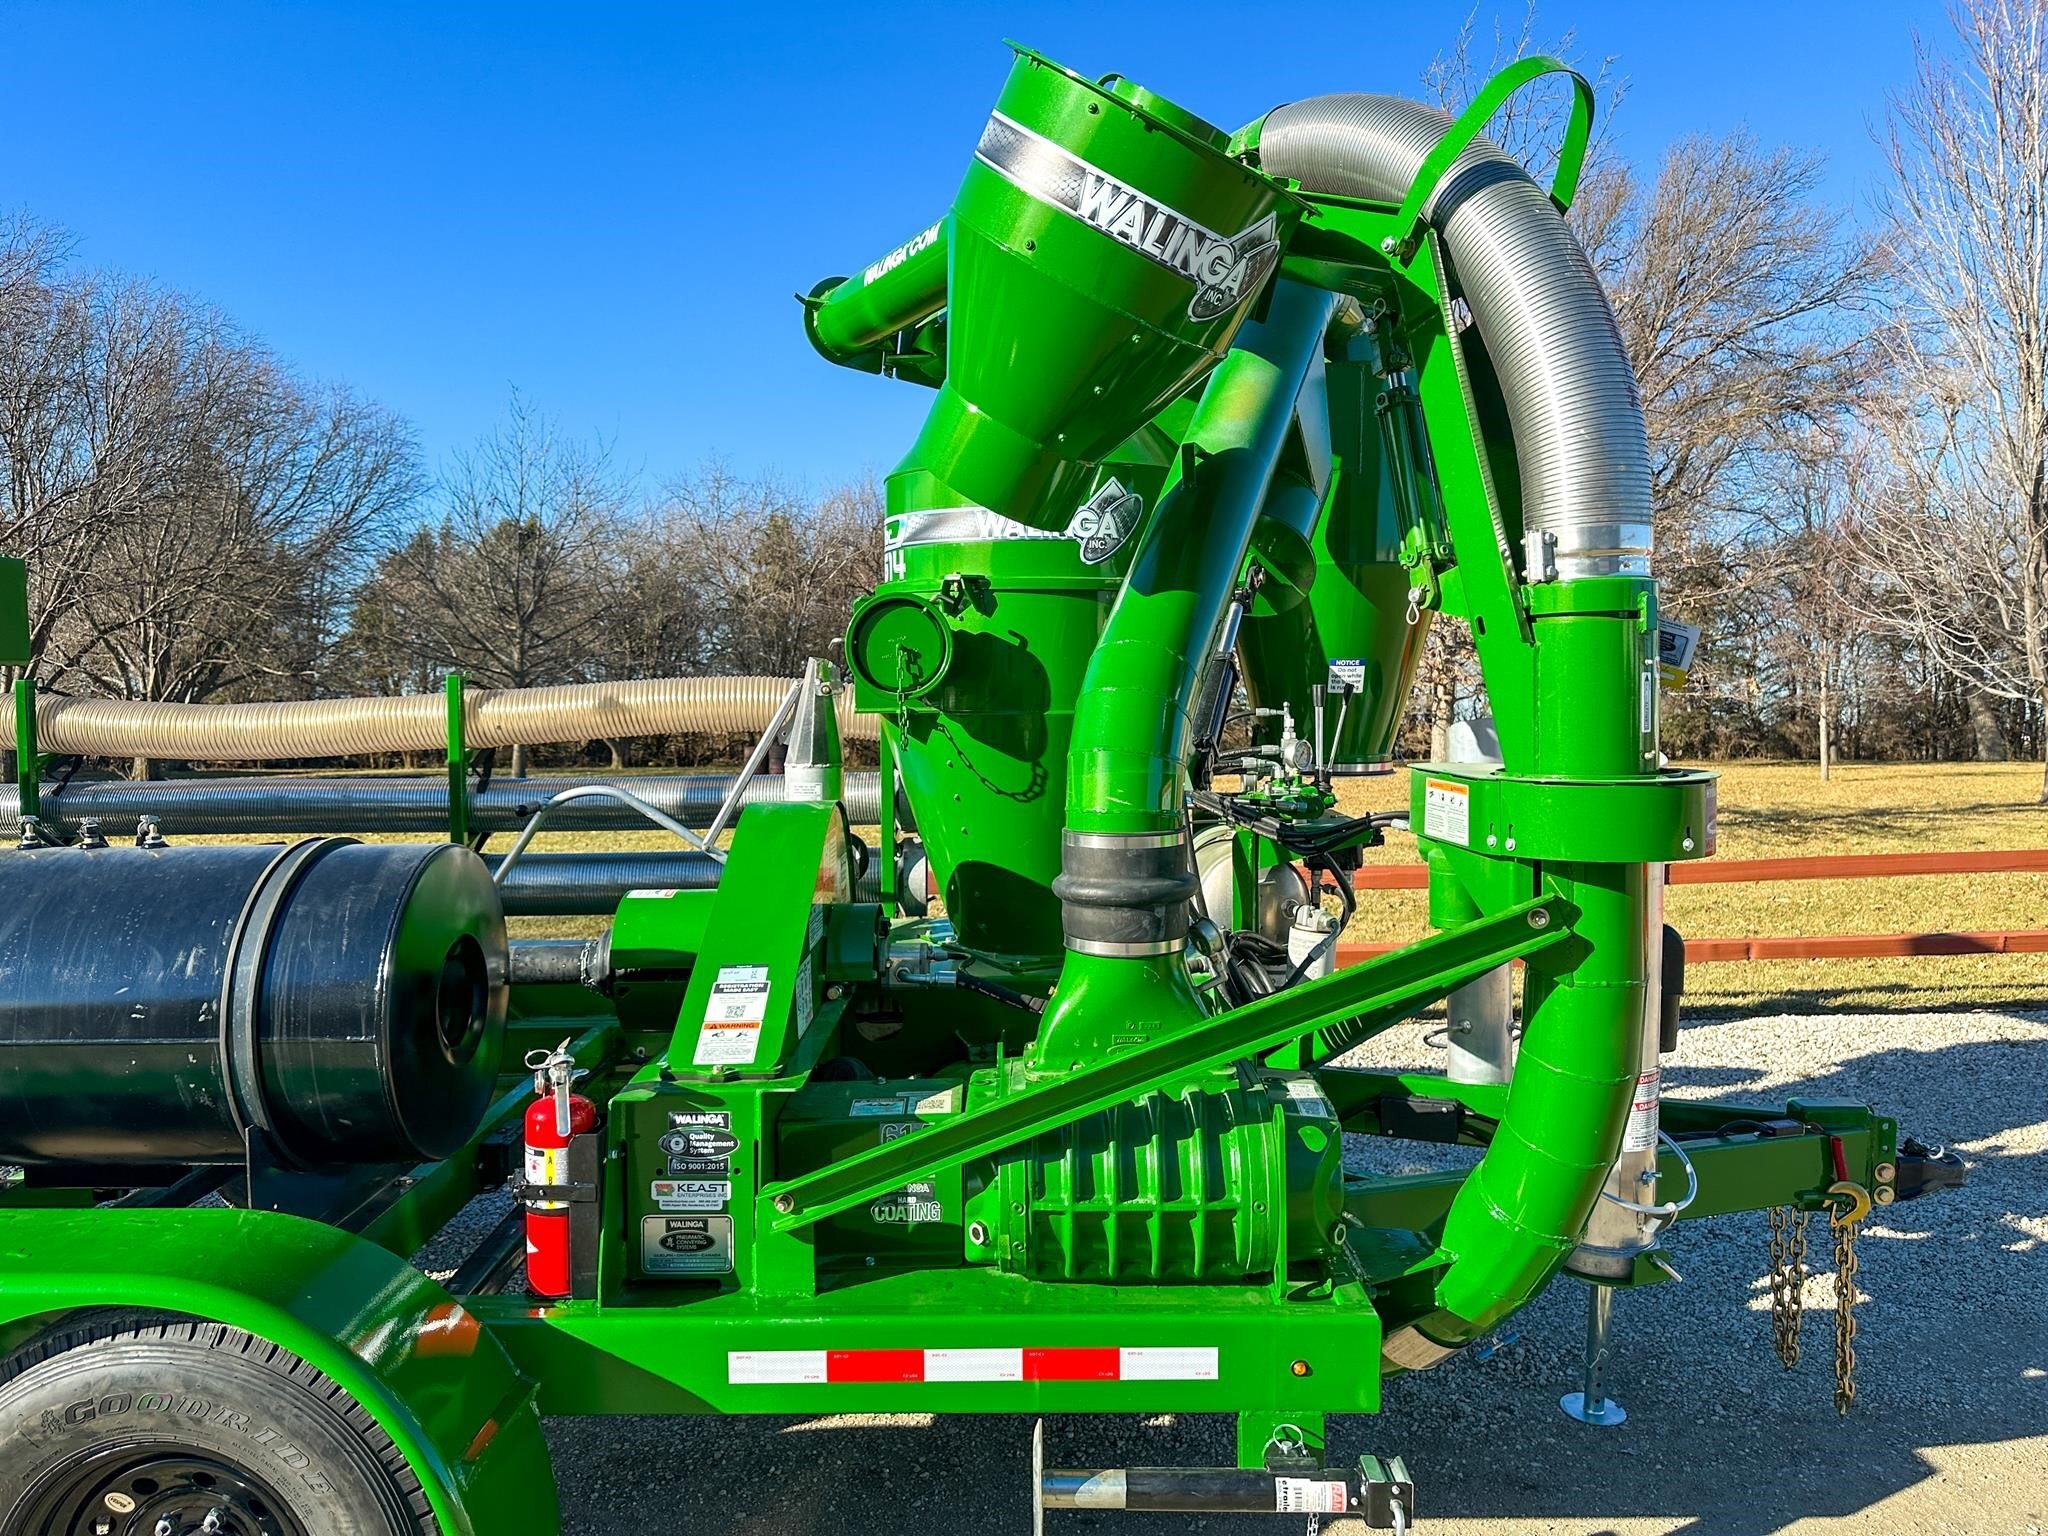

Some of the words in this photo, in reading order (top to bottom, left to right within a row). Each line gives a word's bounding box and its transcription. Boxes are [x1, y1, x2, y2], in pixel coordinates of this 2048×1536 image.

[1077, 171, 1249, 299] WALINGA
[1204, 288, 1222, 306] INC.
[978, 510, 1120, 540] WAGA
[1089, 540, 1107, 549] INC.
[674, 1114, 724, 1124] WALINGA
[689, 1133, 715, 1141] Quality
[689, 1140, 735, 1148] Management
[673, 1162, 687, 1170] ISO
[688, 1162, 725, 1170] 9001:2015
[677, 1183, 728, 1193] KEAST
[897, 1196, 917, 1204] HARD
[873, 1201, 941, 1221] COATING
[669, 1220, 704, 1228] WALINGA
[64, 1392, 337, 1495] GOODRIDE
